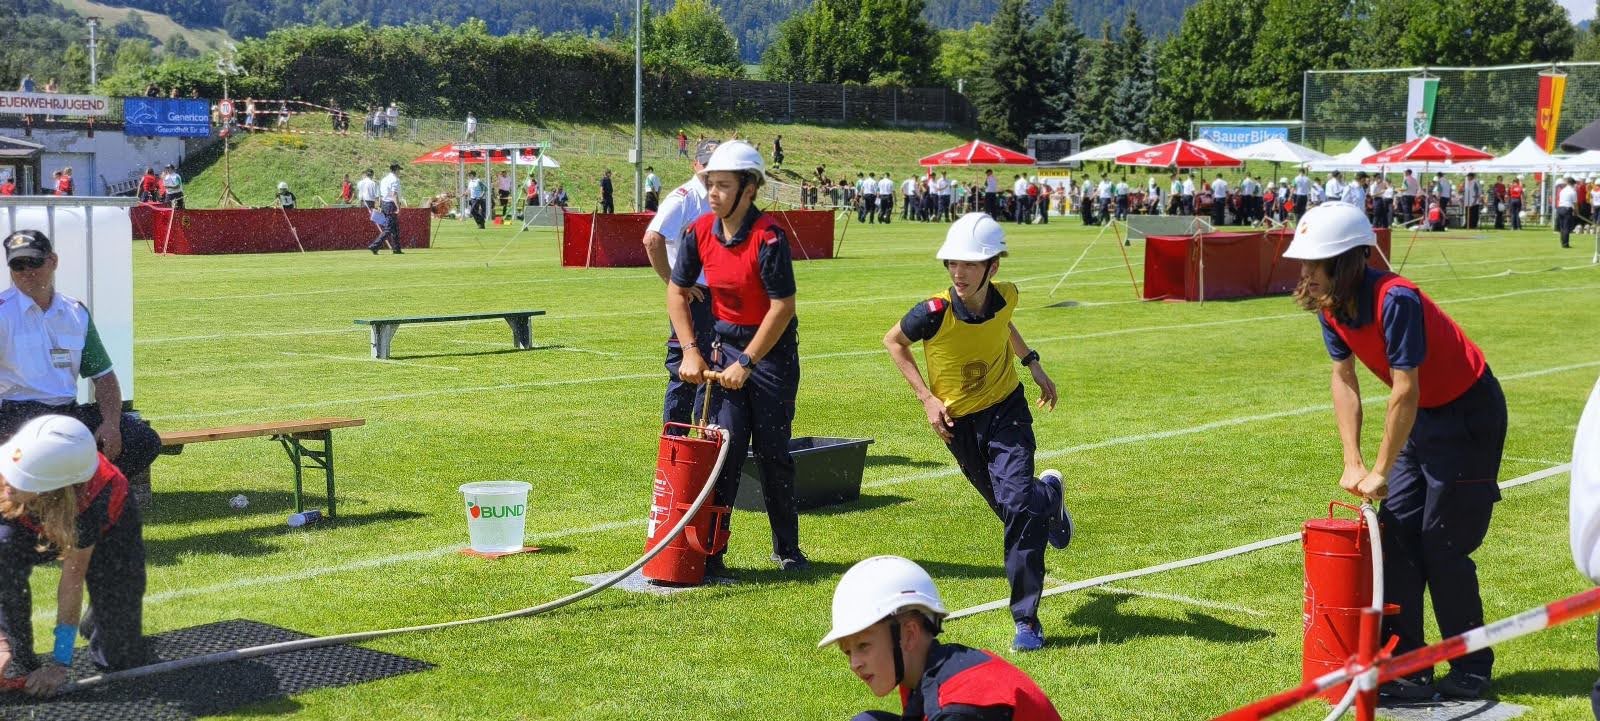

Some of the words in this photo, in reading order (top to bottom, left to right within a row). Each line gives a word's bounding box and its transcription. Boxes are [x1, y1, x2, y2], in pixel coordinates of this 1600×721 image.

[0, 96, 105, 111] EUERWEHRJUGEND
[167, 112, 209, 122] Genericon
[481, 504, 525, 518] BUND
